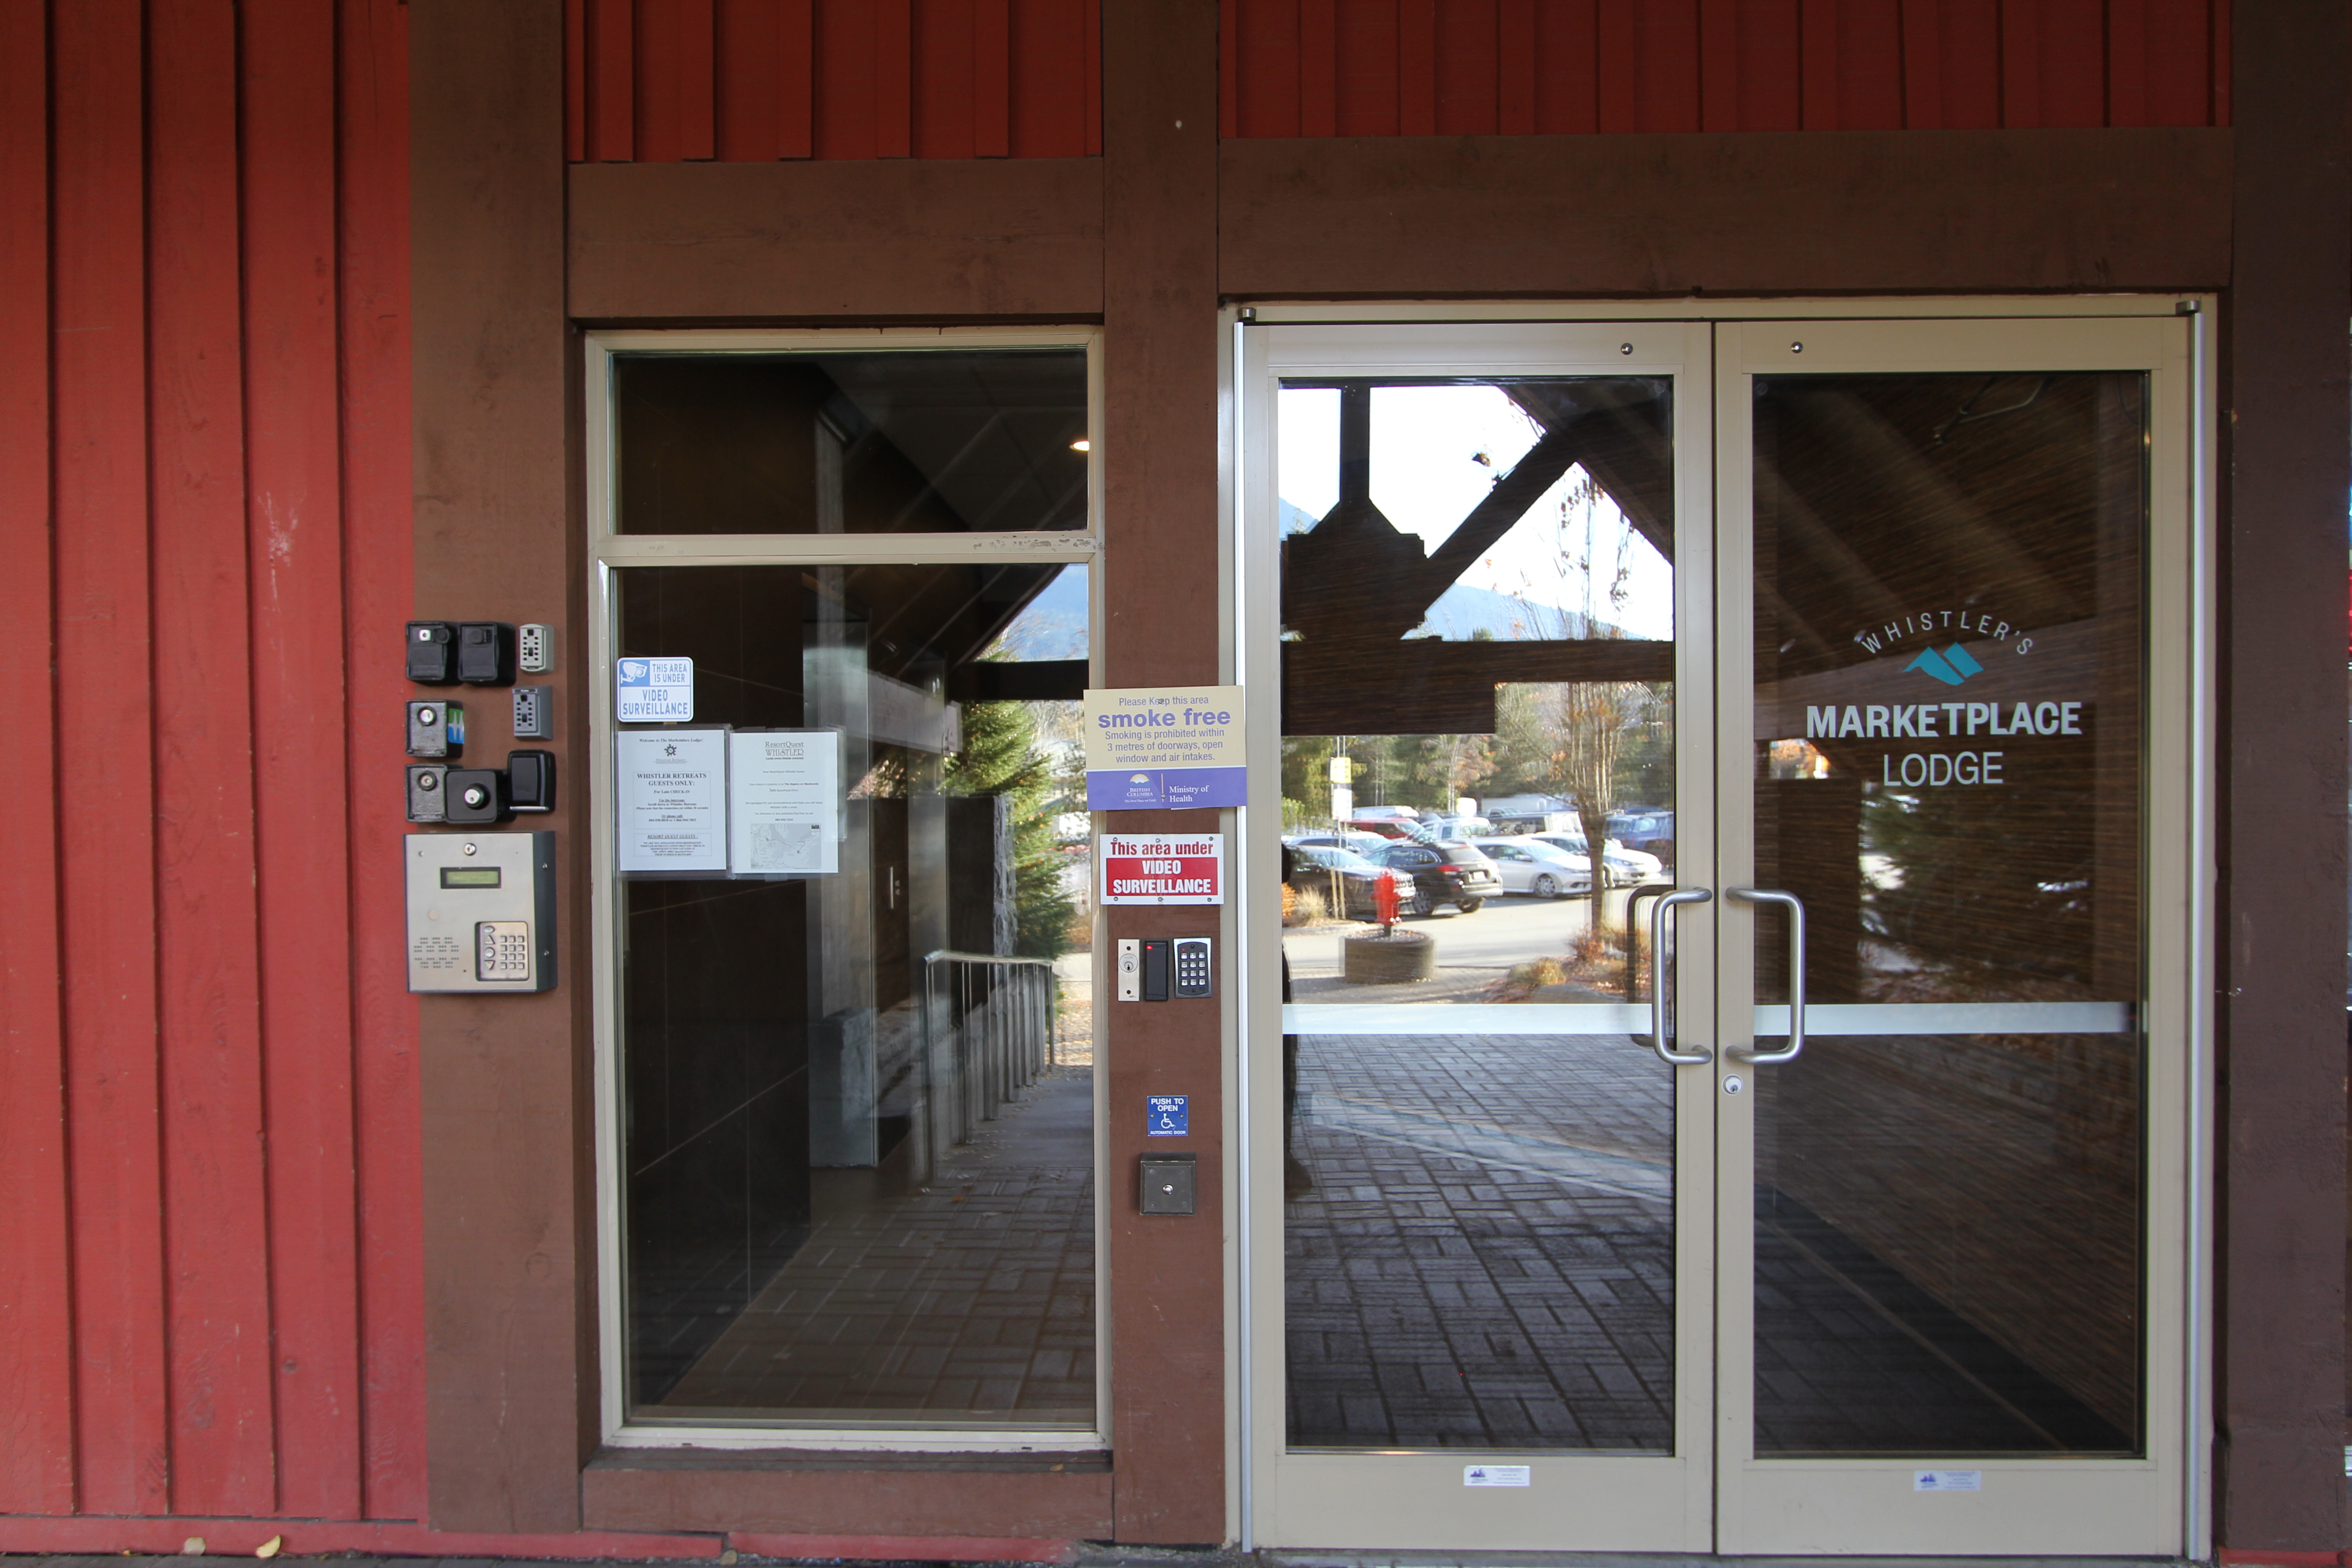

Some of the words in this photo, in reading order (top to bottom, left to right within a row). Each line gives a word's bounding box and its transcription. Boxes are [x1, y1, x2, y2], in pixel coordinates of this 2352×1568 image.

[1861, 611, 2033, 655] WHISTLER'S
[652, 664, 667, 673] THIS
[669, 663, 687, 672] AREA
[654, 674, 661, 683] IS
[663, 674, 686, 683] UNDER
[642, 689, 668, 702] VIDEO
[1119, 697, 1147, 706] Please
[1172, 696, 1188, 705] this
[622, 702, 688, 715] SURVEILLANCE
[1098, 709, 1176, 728] smoke
[1183, 708, 1230, 725] free
[1807, 701, 2082, 738] MARKETPLACE
[1105, 731, 1142, 740] Smoking
[1145, 730, 1152, 738] is
[1154, 729, 1196, 740] prohibited
[1199, 728, 1225, 737] within
[1107, 743, 1113, 751] 3
[1115, 743, 1145, 751] metres
[1147, 741, 1156, 750] of
[1157, 741, 1200, 752] doorways,
[1202, 741, 1223, 750] open
[1116, 754, 1149, 763] window
[1151, 753, 1166, 762] and
[1169, 753, 1180, 762] air
[1182, 752, 1215, 761] intakes.
[1883, 751, 2004, 787] LODGE
[1169, 786, 1199, 794] Ministry
[1111, 842, 1137, 855] This
[1142, 843, 1171, 855] area
[1176, 840, 1214, 855] under
[1142, 860, 1181, 875] VIDEO
[1113, 878, 1211, 894] SURVEILLANCE
